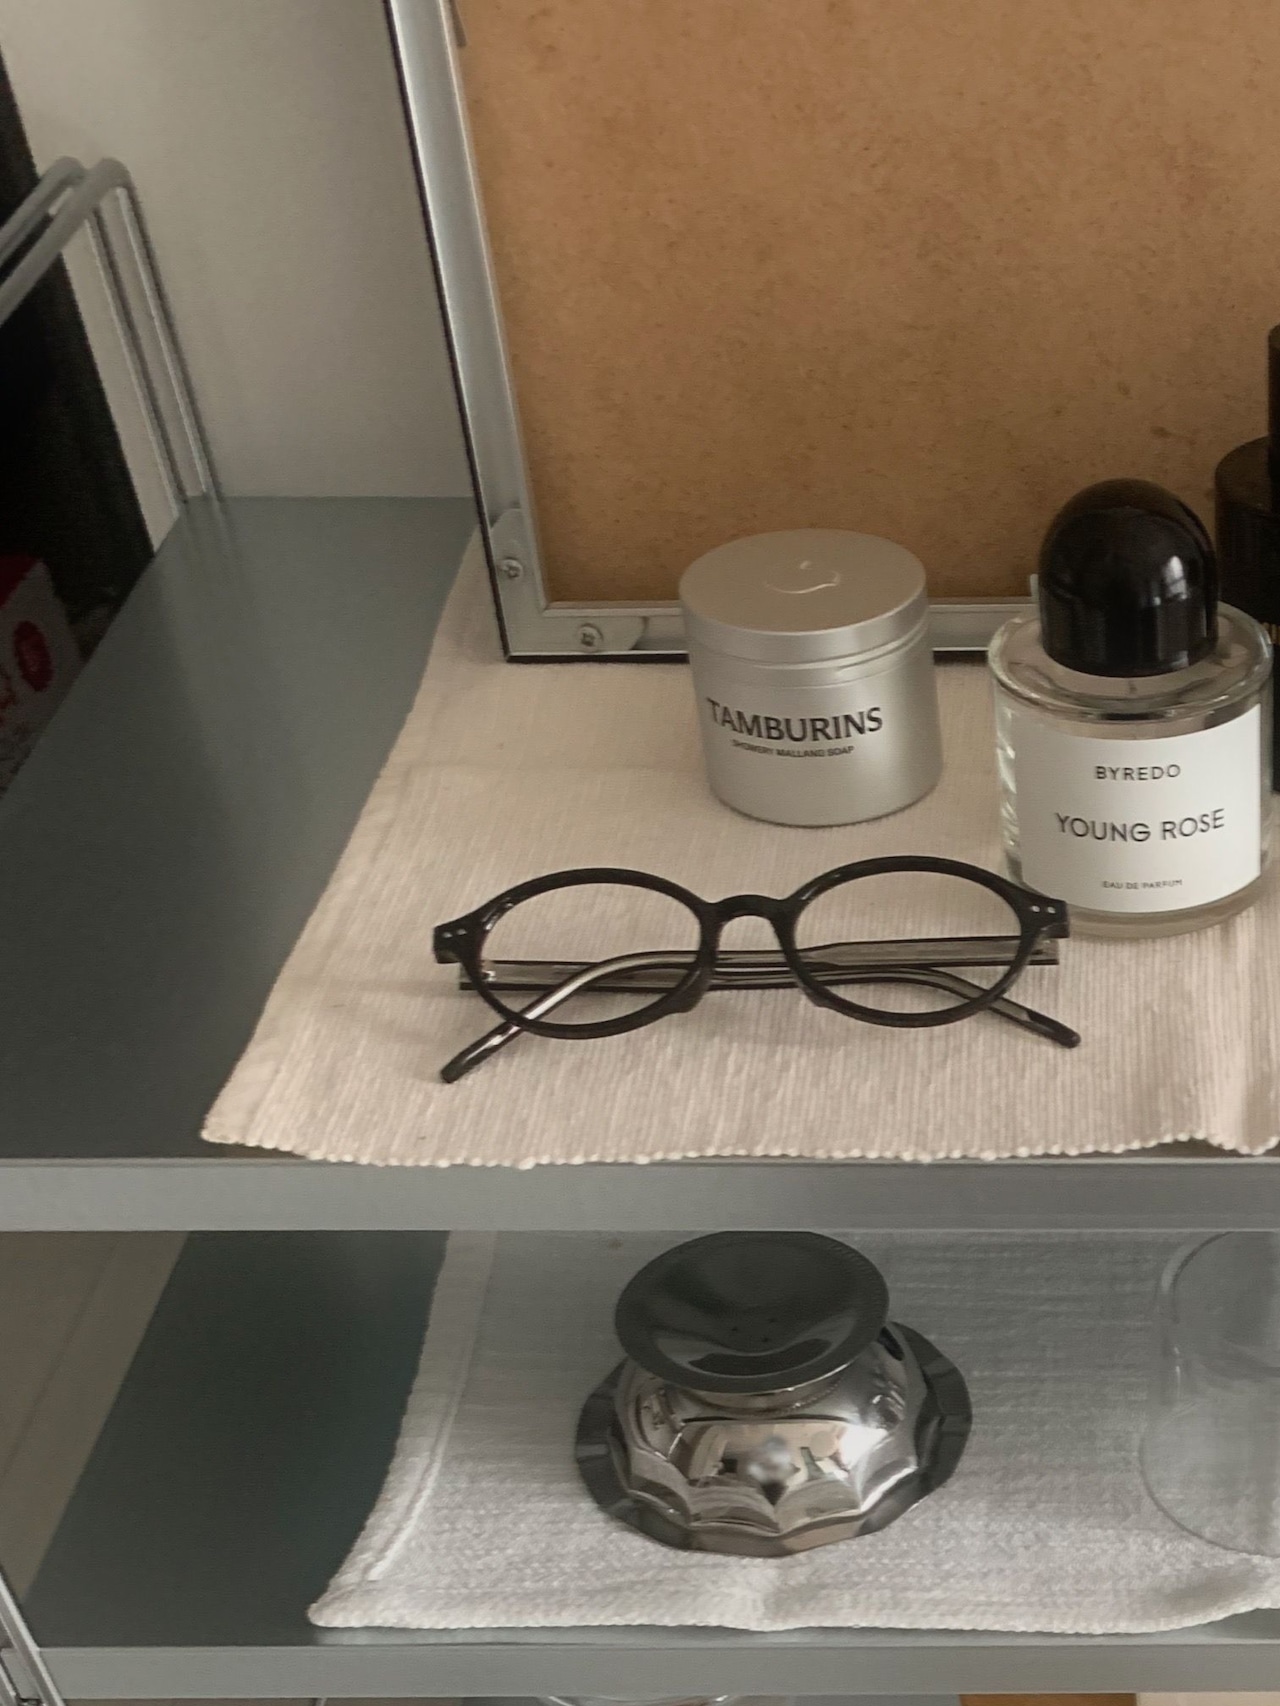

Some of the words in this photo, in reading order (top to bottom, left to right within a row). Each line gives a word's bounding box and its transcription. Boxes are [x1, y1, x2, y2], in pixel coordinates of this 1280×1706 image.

[706, 697, 883, 743] TAMBURINS
[827, 745, 855, 756] SOAP
[1095, 764, 1181, 781] BYREDO
[1054, 812, 1151, 842] YOUNG
[1161, 808, 1225, 840] ROSE
[1103, 880, 1124, 890] EAU
[1126, 881, 1139, 890] DE
[1142, 878, 1182, 889] PARFUM
